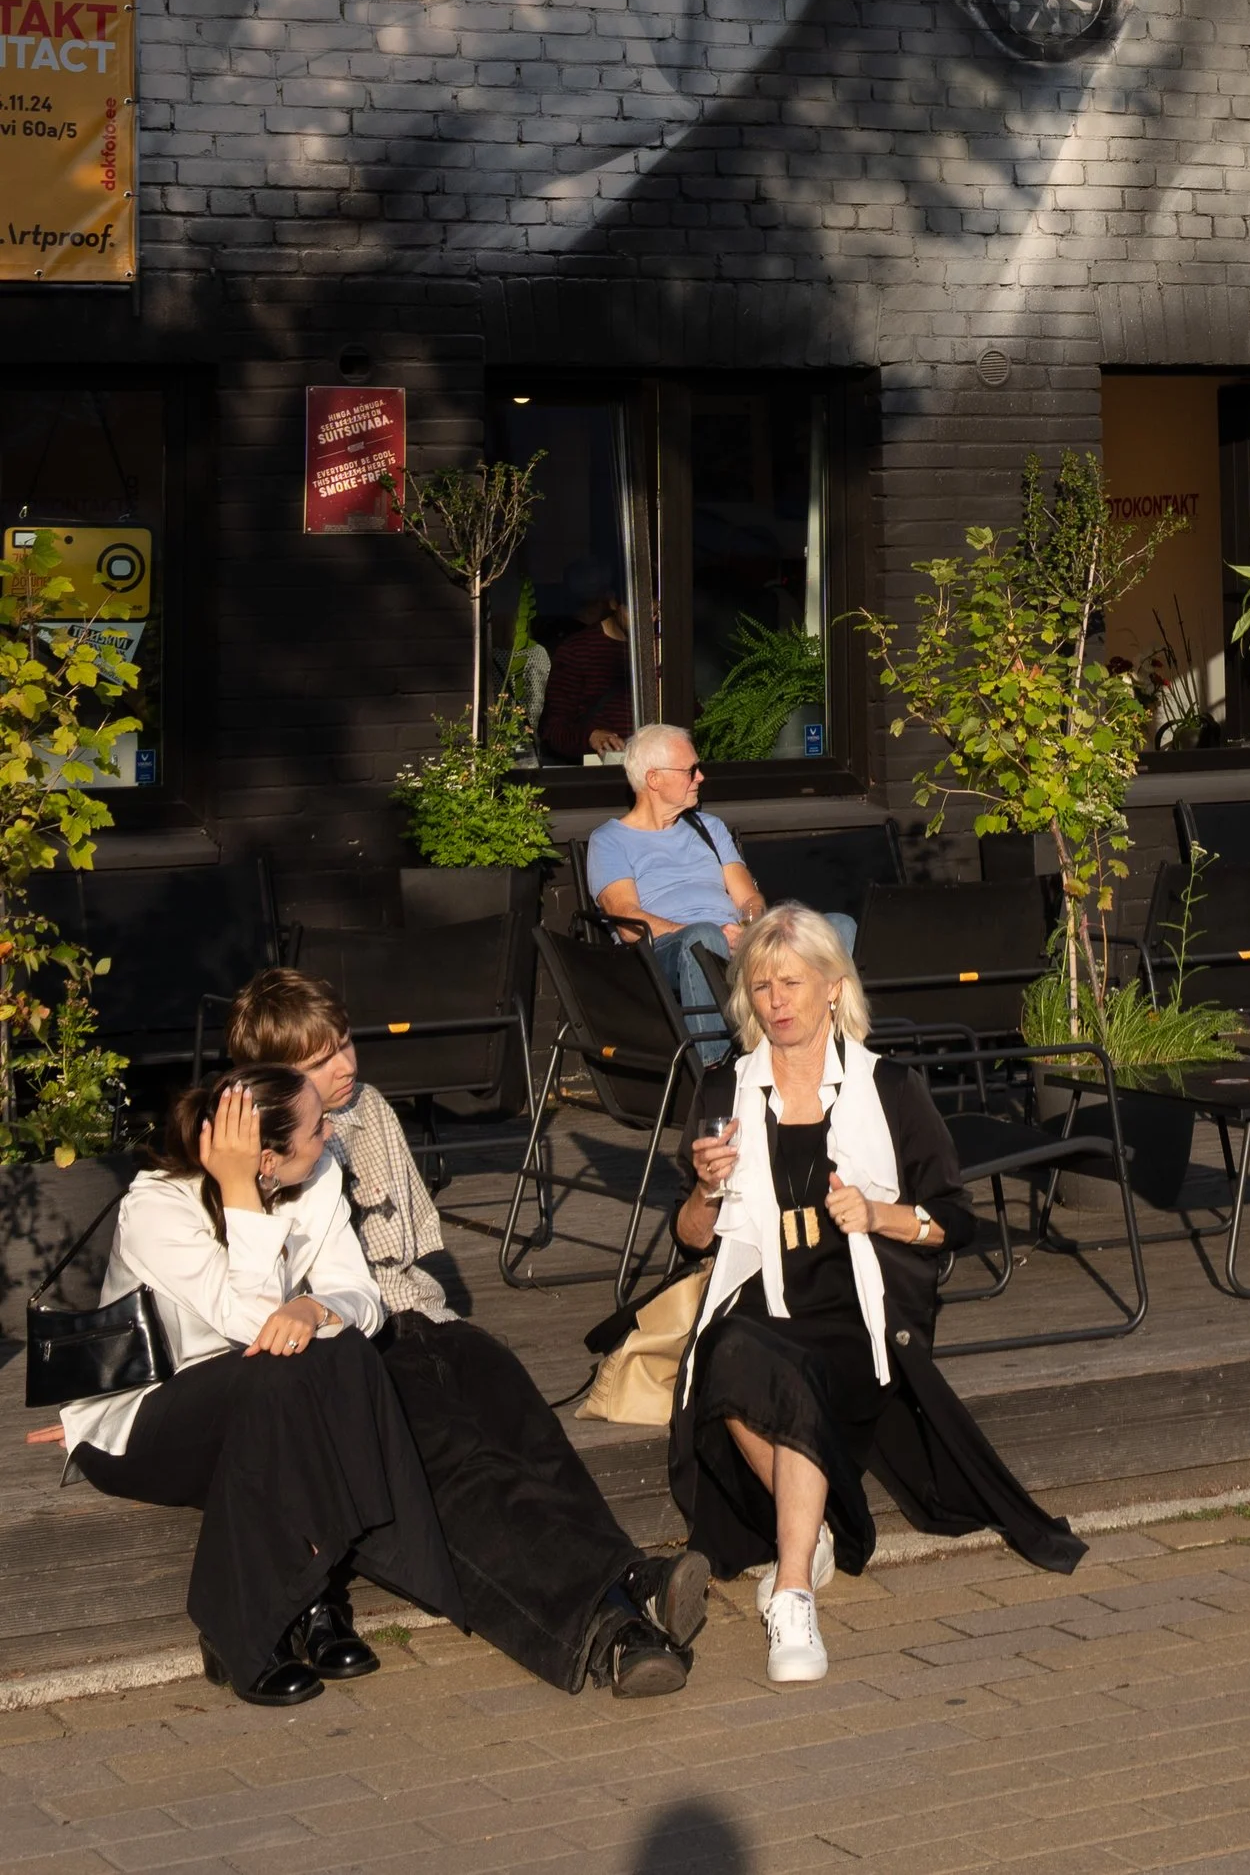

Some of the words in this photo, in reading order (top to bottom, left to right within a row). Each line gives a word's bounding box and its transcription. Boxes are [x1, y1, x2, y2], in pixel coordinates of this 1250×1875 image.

[0, 34, 117, 74] TACT
[22, 120, 77, 141] 60a/5
[101, 97, 117, 191] dokfoto.ee
[317, 414, 394, 445] SUITSUVABA.
[312, 478, 331, 488] THIS
[367, 460, 387, 472] HERE
[388, 457, 396, 465] IS
[316, 460, 358, 479] EVERYBODY
[360, 456, 371, 466] BE
